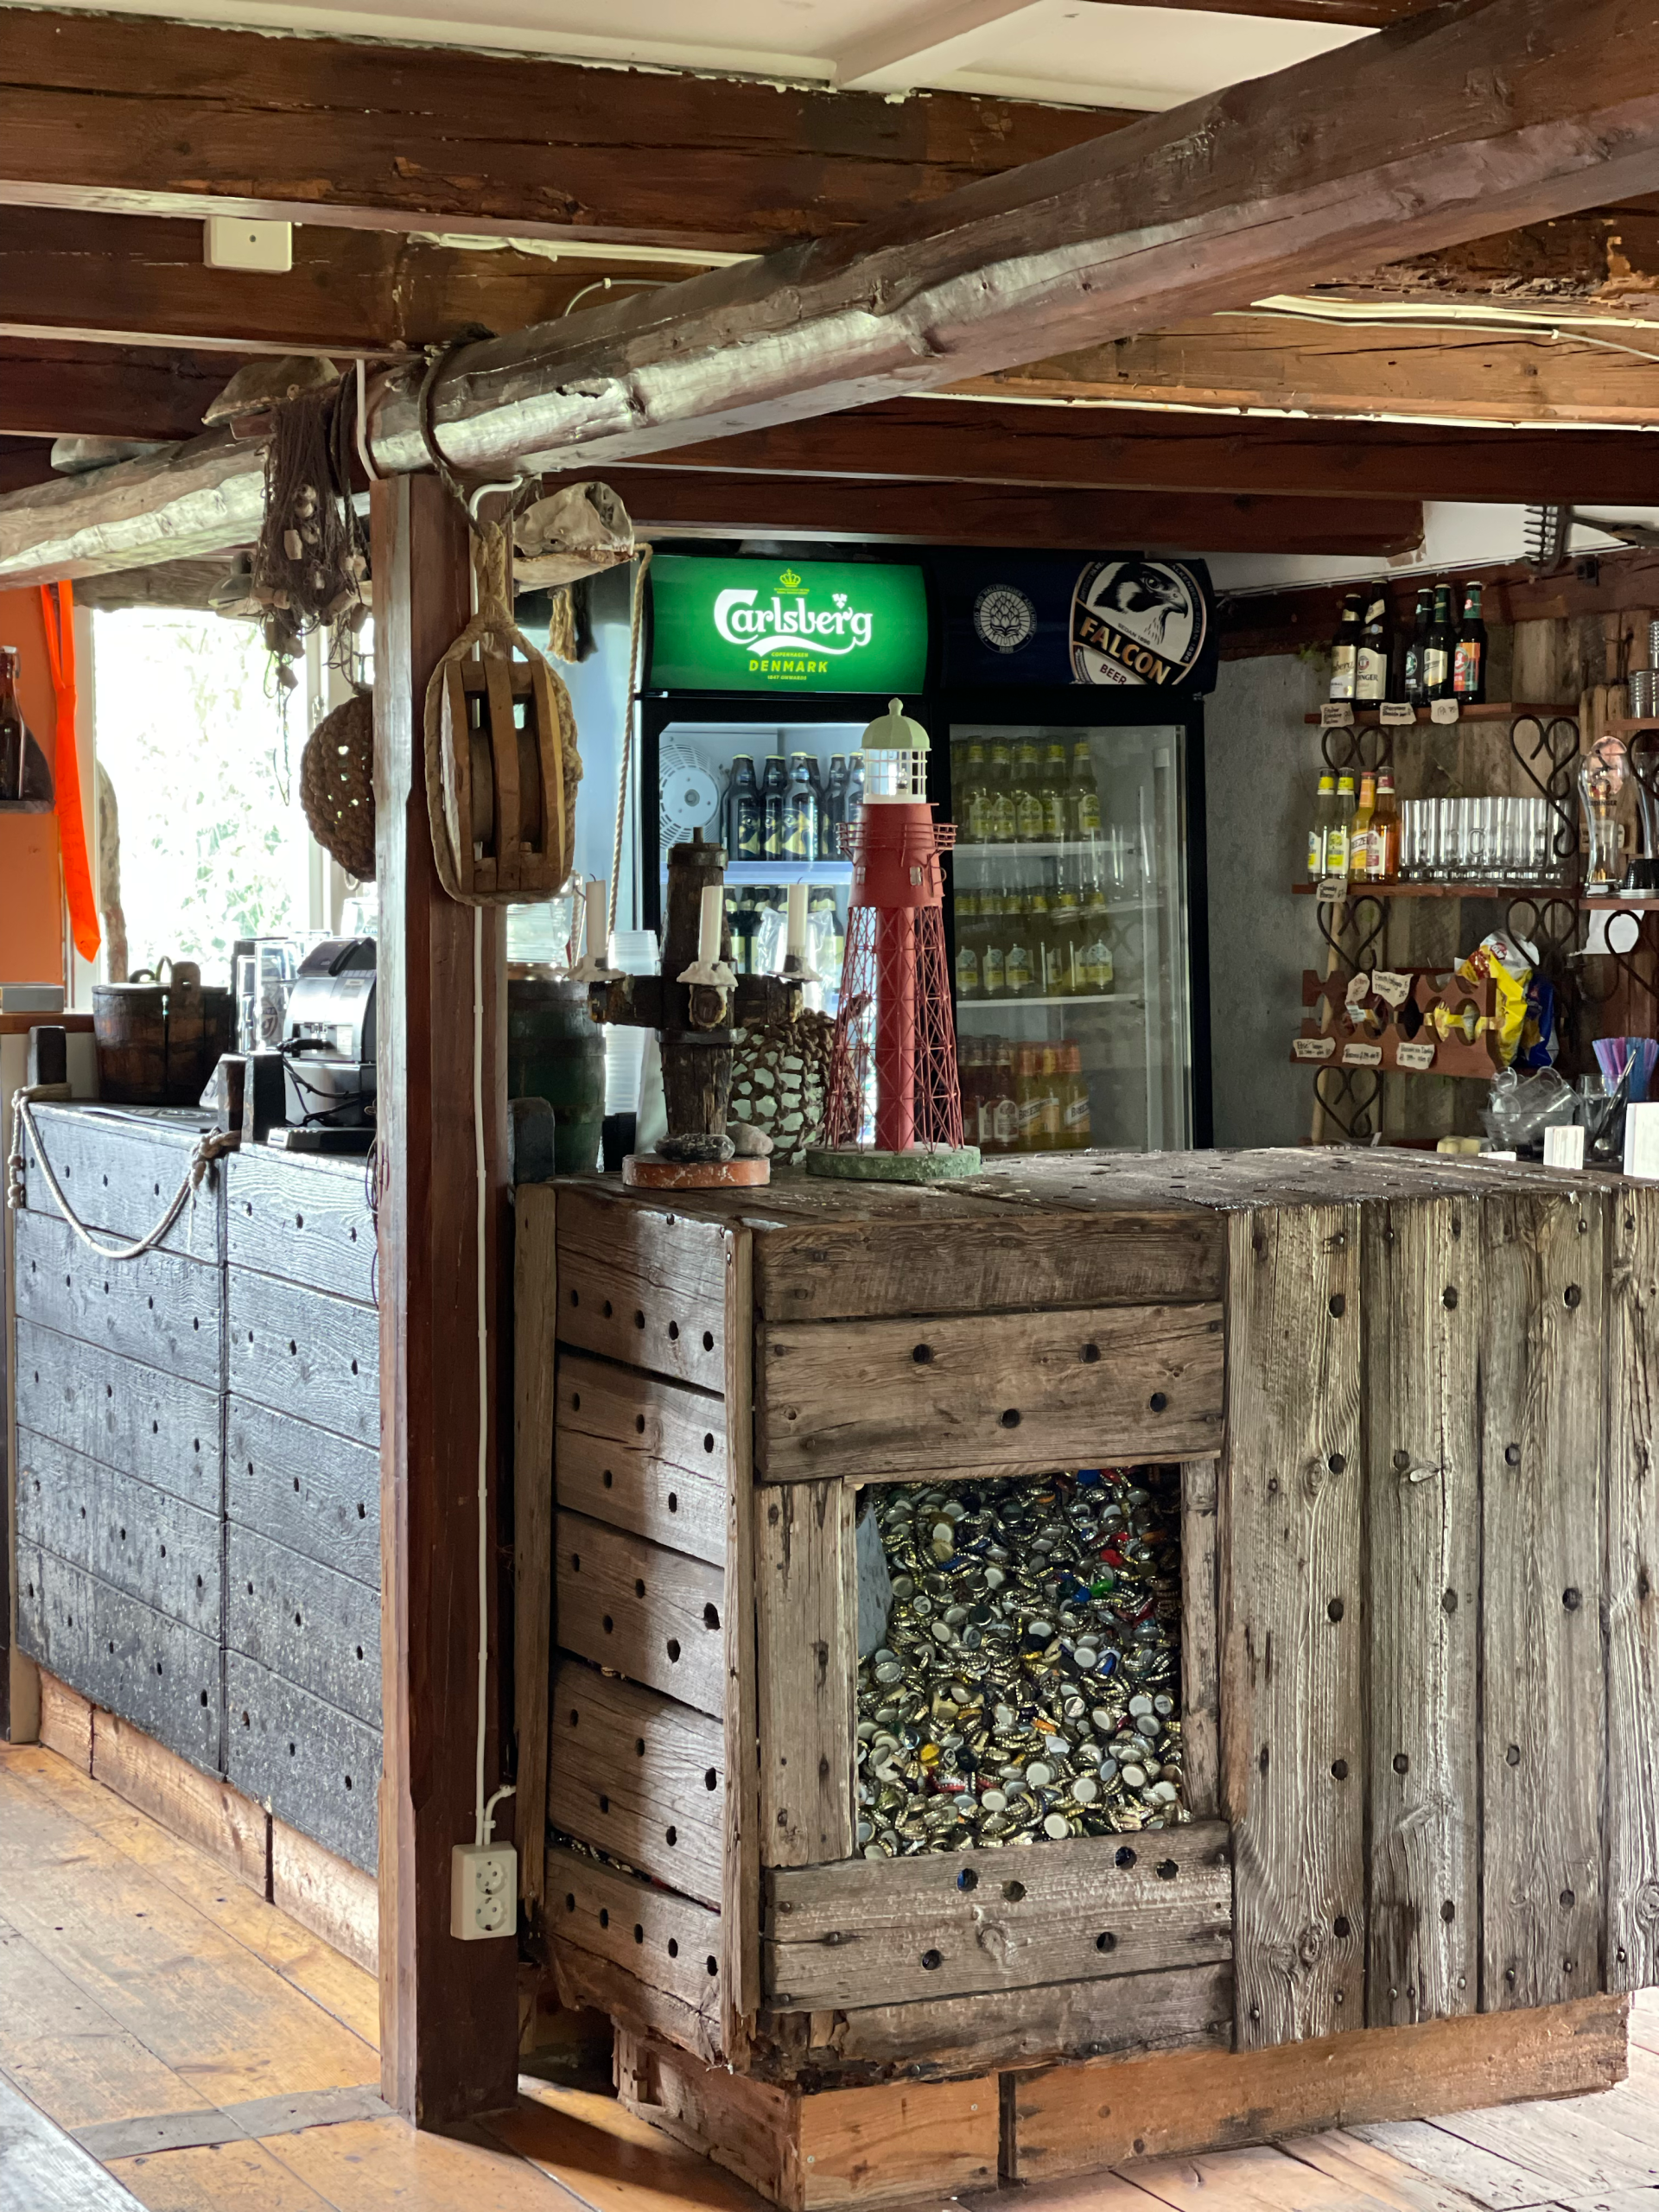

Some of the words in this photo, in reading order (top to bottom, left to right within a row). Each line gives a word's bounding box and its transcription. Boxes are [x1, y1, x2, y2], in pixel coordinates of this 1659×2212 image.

[1169, 563, 1200, 608] ALKENBERG
[714, 588, 874, 646] Carlsberg
[1118, 622, 1137, 638] SEDAN
[1138, 635, 1151, 645] 1896
[748, 659, 829, 673] DENMARK
[1079, 616, 1172, 685] FALCON
[1099, 664, 1128, 685] BEER
